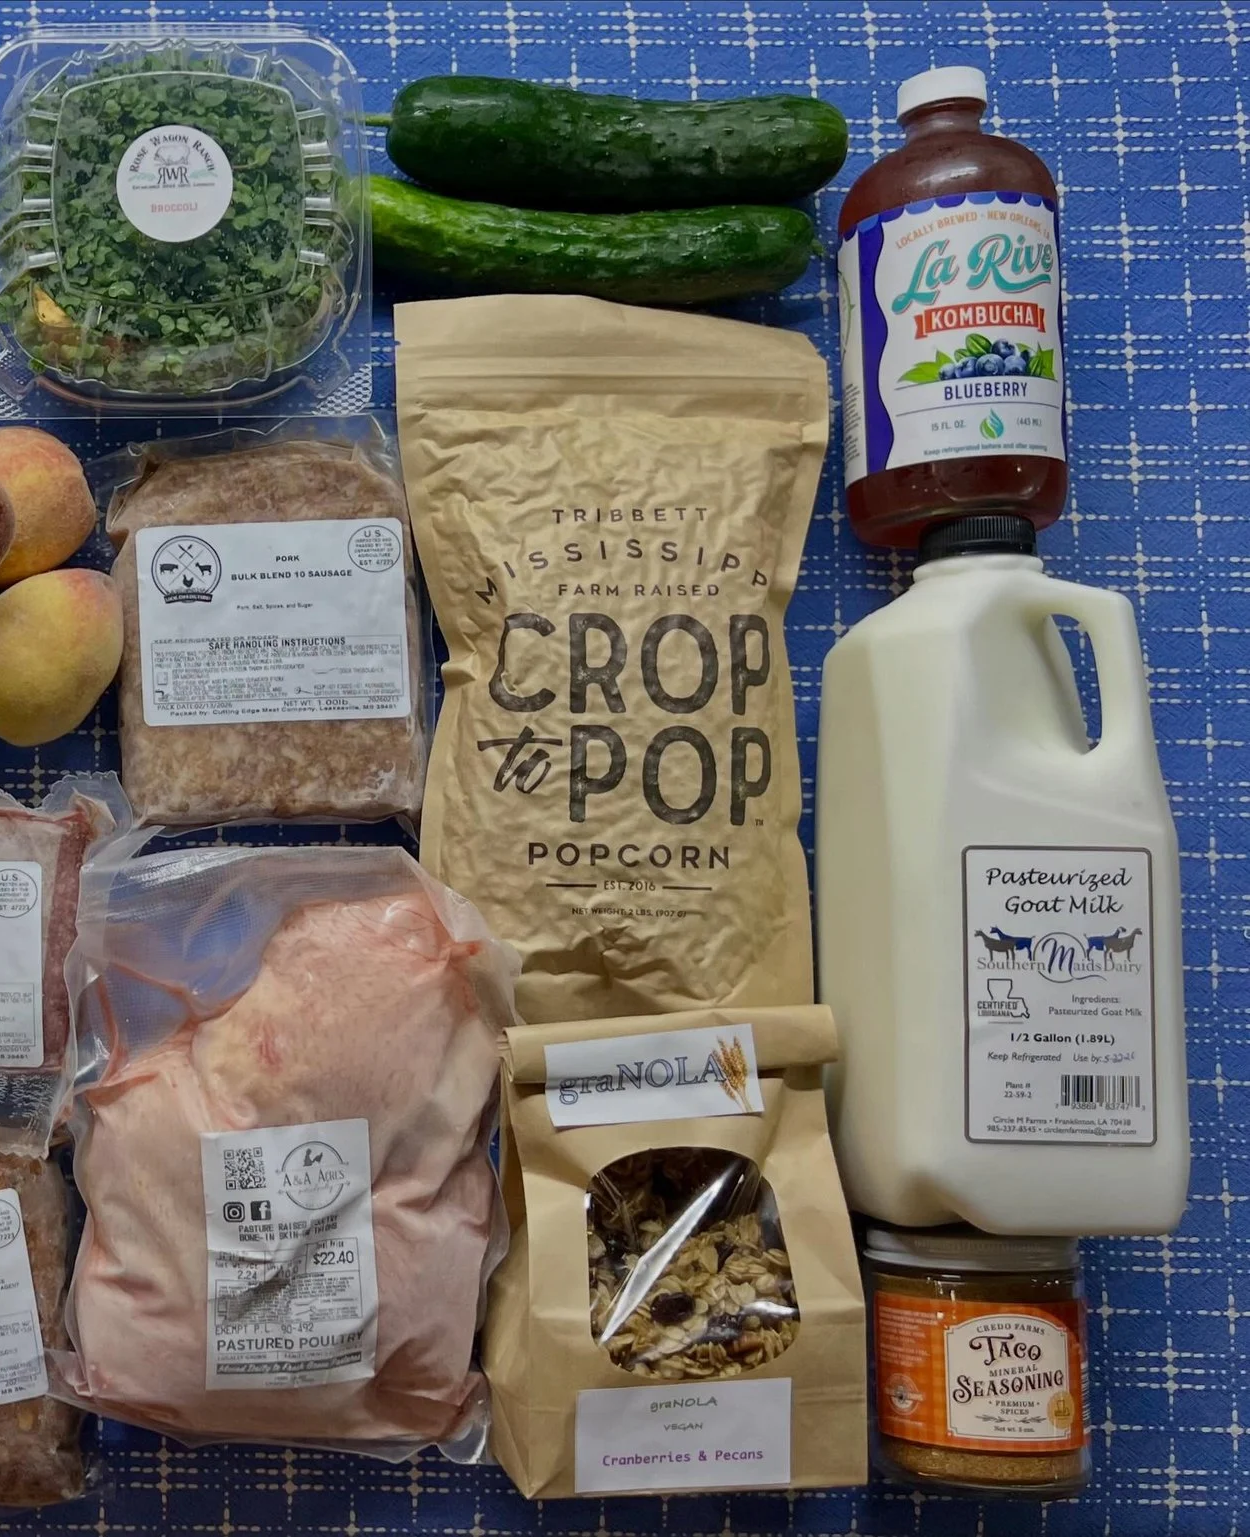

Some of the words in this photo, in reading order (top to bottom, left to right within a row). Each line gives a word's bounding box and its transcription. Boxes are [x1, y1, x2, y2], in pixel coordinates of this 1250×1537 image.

[130, 146, 148, 172] ROSE
[150, 134, 189, 146] WAGON
[192, 140, 215, 171] RANCH
[151, 202, 198, 213] BROCCOLI
[895, 225, 934, 249] LOCALLY
[937, 211, 978, 229] BREWED
[987, 210, 1006, 221] NEW
[891, 238, 959, 316] La
[931, 305, 1034, 330] KOMBUCHA
[944, 382, 1028, 401] BLUEBERRY
[552, 507, 708, 524] TRIBBETT
[275, 555, 300, 563] PORK
[231, 573, 257, 581] BULK
[260, 572, 292, 580] BLEND
[295, 571, 306, 579] 10
[308, 569, 353, 578] SAUSAGE
[475, 538, 768, 605] MISSISSIPP
[558, 583, 619, 596] FARM
[635, 583, 719, 597] RAISED
[209, 641, 231, 651] SAFE
[233, 639, 279, 649] HANDLING
[281, 637, 346, 648] INSTRUCTIONS
[488, 612, 770, 716] CROP
[477, 725, 563, 794] to
[570, 724, 771, 826] POP
[528, 841, 729, 869] POPCORN
[603, 880, 626, 890] EST.
[629, 880, 656, 891] 2016
[985, 867, 1132, 892] Pasteurized
[1005, 896, 1065, 915] Goat
[1069, 894, 1123, 915] Milk
[977, 956, 1047, 972] Southern
[1103, 959, 1143, 976] Dairy
[977, 1000, 1017, 1010] CERTIFIED
[1048, 1007, 1098, 1016] Pasteurized
[1101, 1008, 1123, 1016] Goat
[1125, 1008, 1142, 1016] Milk
[1010, 1033, 1030, 1043] 1/2
[1034, 1033, 1072, 1043] Gallon
[1075, 1033, 1115, 1046] (1.89L)
[987, 1052, 1009, 1062] Keep
[1012, 1052, 1062, 1064] Refrigerated
[1073, 1054, 1089, 1062] Use
[558, 1053, 726, 1105] graNOLA
[318, 1168, 345, 1182] ACRES
[238, 1224, 274, 1233] PASTURE
[278, 1221, 307, 1231] RAISED
[239, 1233, 275, 1242] BONE-IN
[313, 1250, 355, 1266] $22.40
[237, 1269, 257, 1280] 2.24
[215, 1323, 248, 1336] EXEMPT
[976, 1323, 1012, 1334] CREDO
[1014, 1324, 1046, 1336] FARMS
[217, 1337, 294, 1351] PASTURED
[300, 1329, 364, 1349] POULTRY
[969, 1333, 1042, 1366] TACO
[989, 1364, 1038, 1377] MINERAL
[952, 1370, 1065, 1404] SEASONING
[650, 1396, 718, 1412] graNOLA
[1000, 1408, 1030, 1416] SPICES
[663, 1422, 703, 1432] VEGAN
[602, 1451, 691, 1467] Cranberries
[698, 1451, 707, 1461] &
[715, 1449, 764, 1462] Pecans
